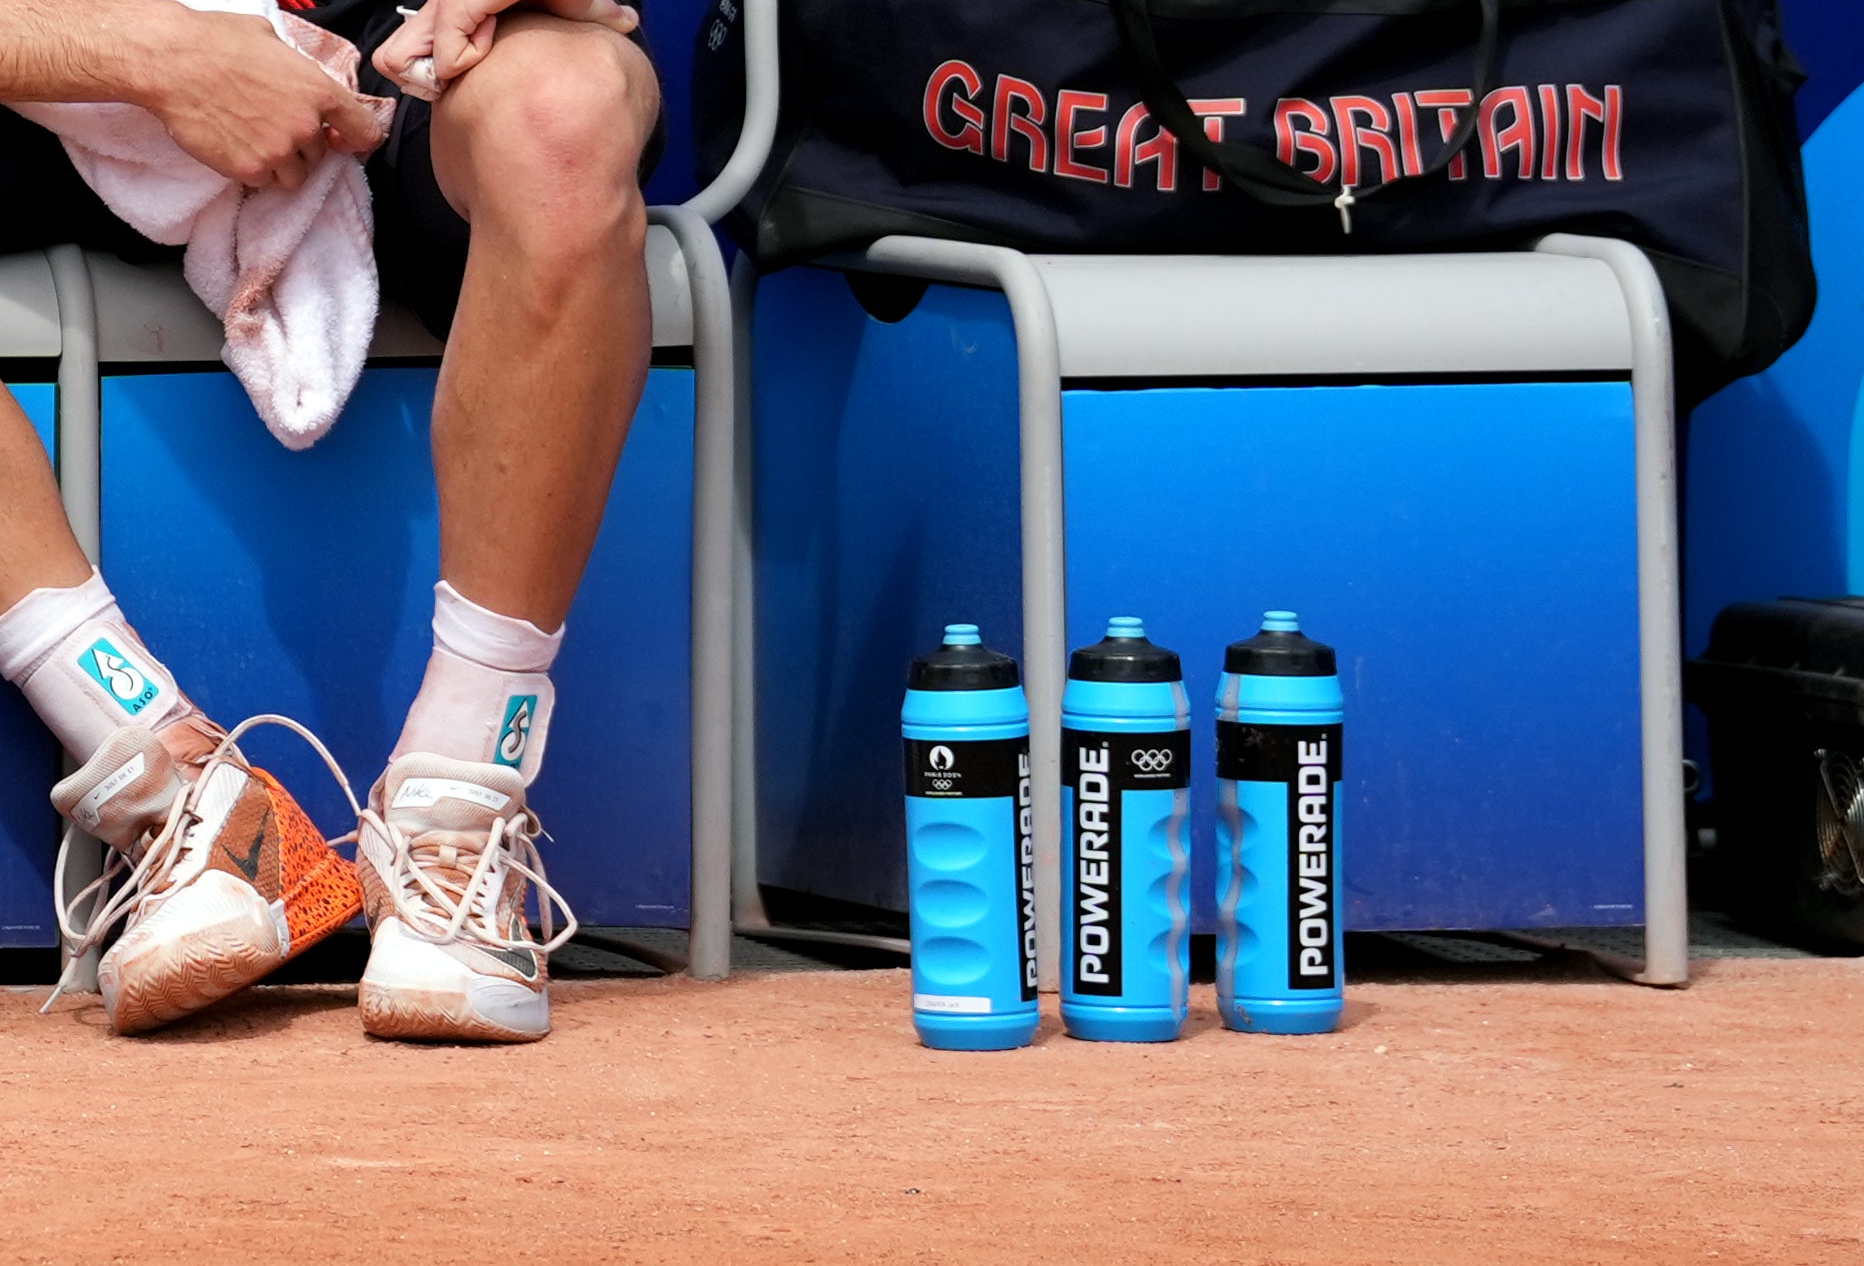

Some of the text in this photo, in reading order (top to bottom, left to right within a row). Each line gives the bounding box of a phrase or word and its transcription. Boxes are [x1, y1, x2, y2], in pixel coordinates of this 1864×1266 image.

[922, 59, 1624, 192] GREAT BRITAIN
[1079, 746, 1110, 984] POWERADE
[1298, 740, 1329, 976] POWERADE
